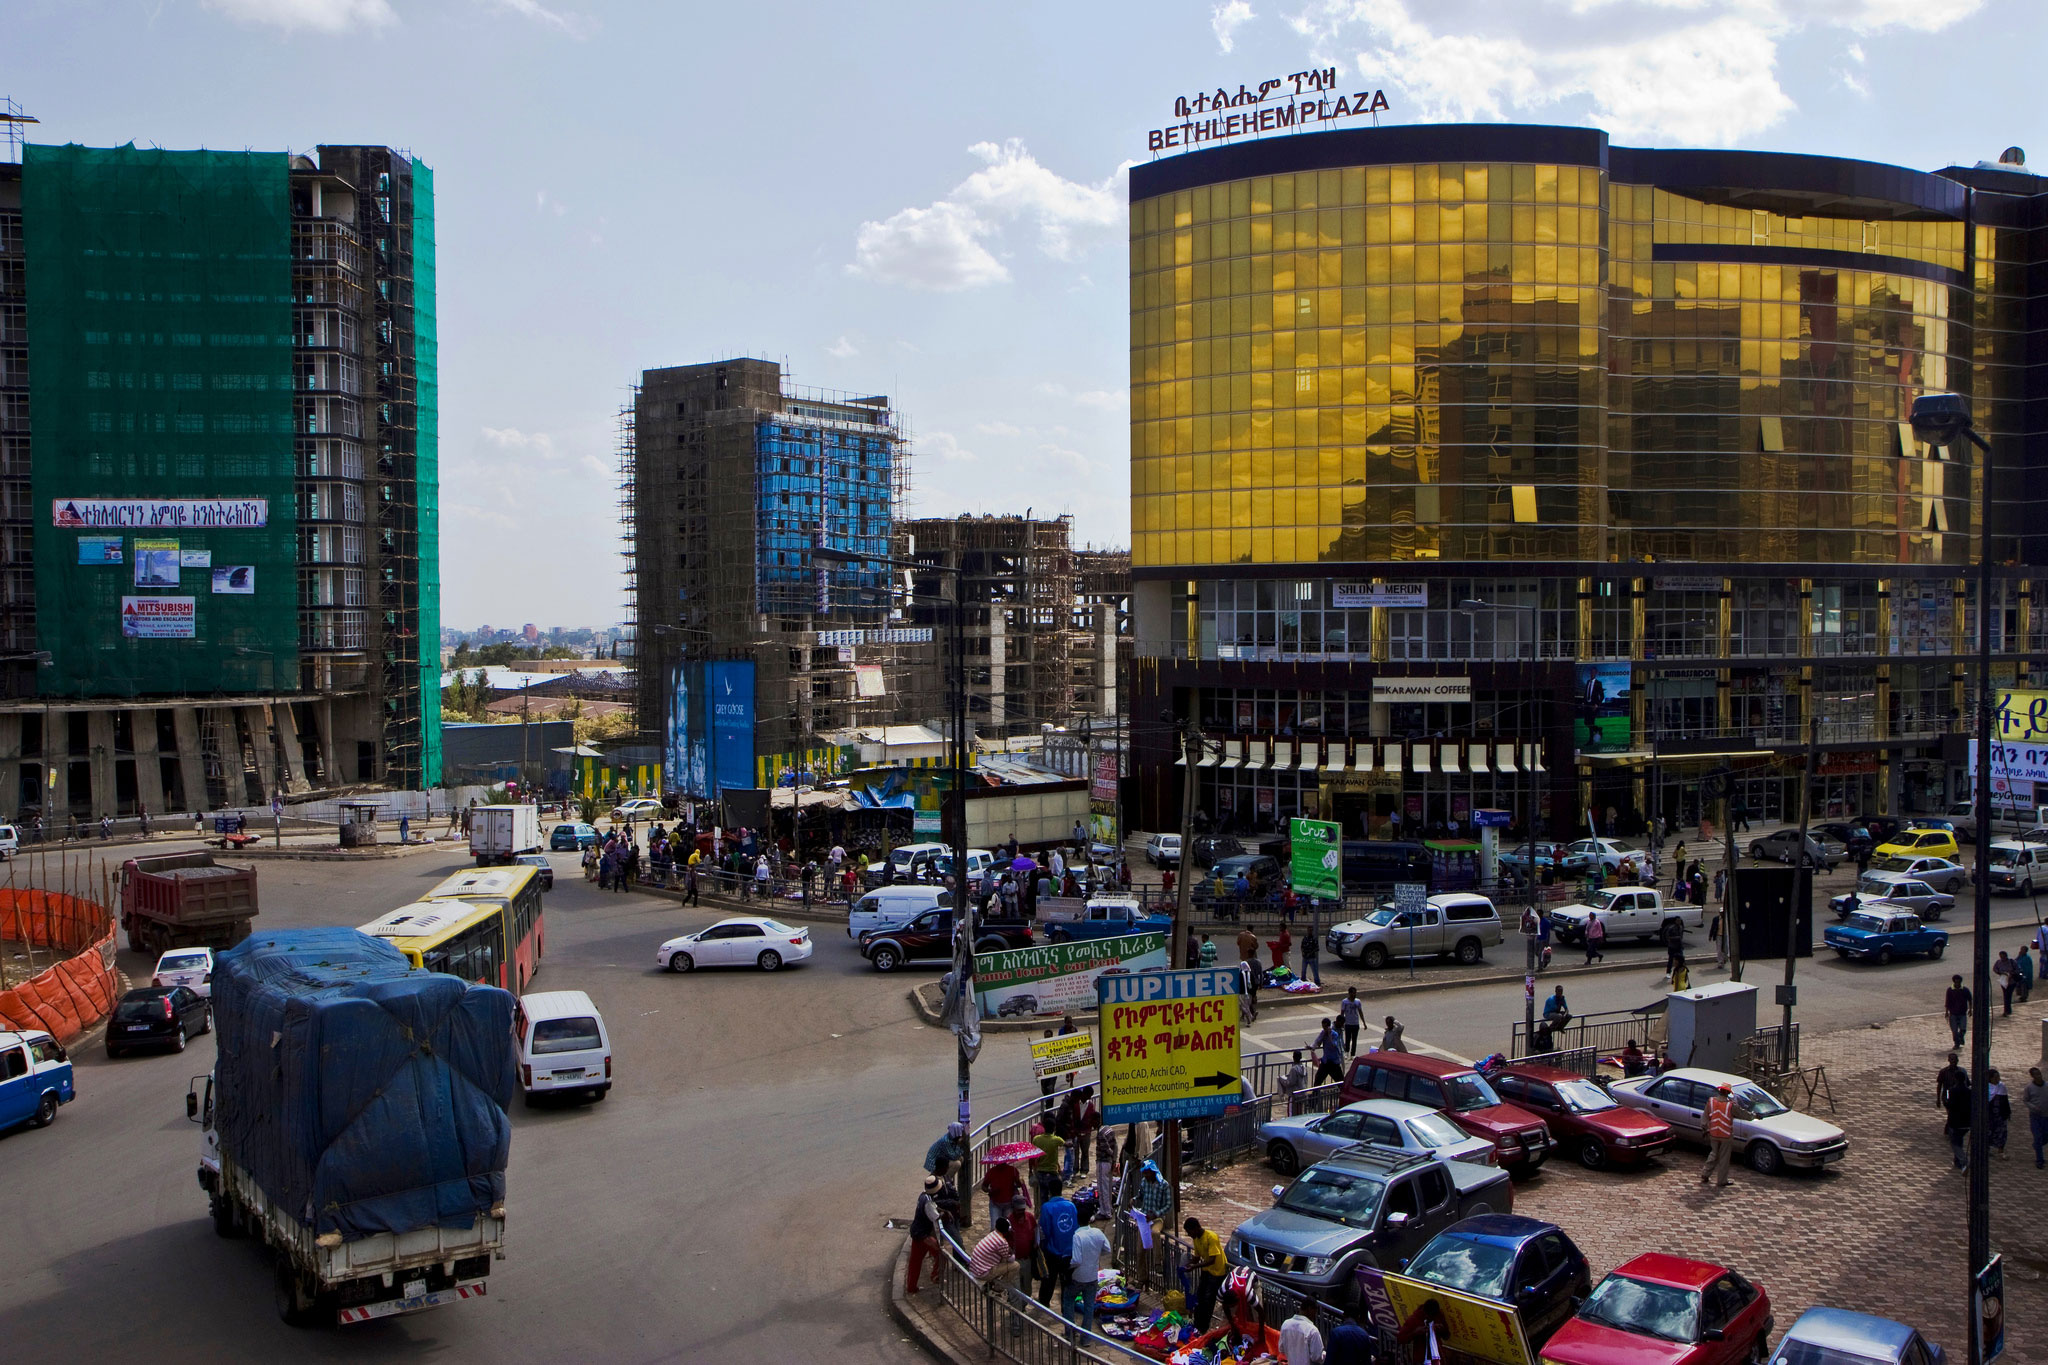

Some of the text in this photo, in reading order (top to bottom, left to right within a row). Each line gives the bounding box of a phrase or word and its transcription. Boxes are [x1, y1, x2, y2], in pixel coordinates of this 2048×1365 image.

[1288, 67, 1336, 95] ፕላዛ
[1148, 89, 1390, 151] BETHLEHEM PLAZA
[1339, 584, 1422, 594] SALON MERON
[137, 603, 193, 611] MITSUBISHI
[1664, 669, 1716, 677] AMBASSADOR
[1385, 685, 1466, 694] KARAVAN COFFEE
[716, 703, 744, 715] GREY GOOSE
[1300, 820, 1326, 838] Cruz
[1015, 965, 1046, 979] Tour
[1048, 963, 1060, 974] &
[1104, 971, 1235, 1004] JUPITER
[1113, 999, 1225, 1030] የኮምፒዩተርና
[1112, 1064, 1187, 1080] Auto CAD, Archi CAD,
[1112, 1083, 1148, 1096] Peachtree
